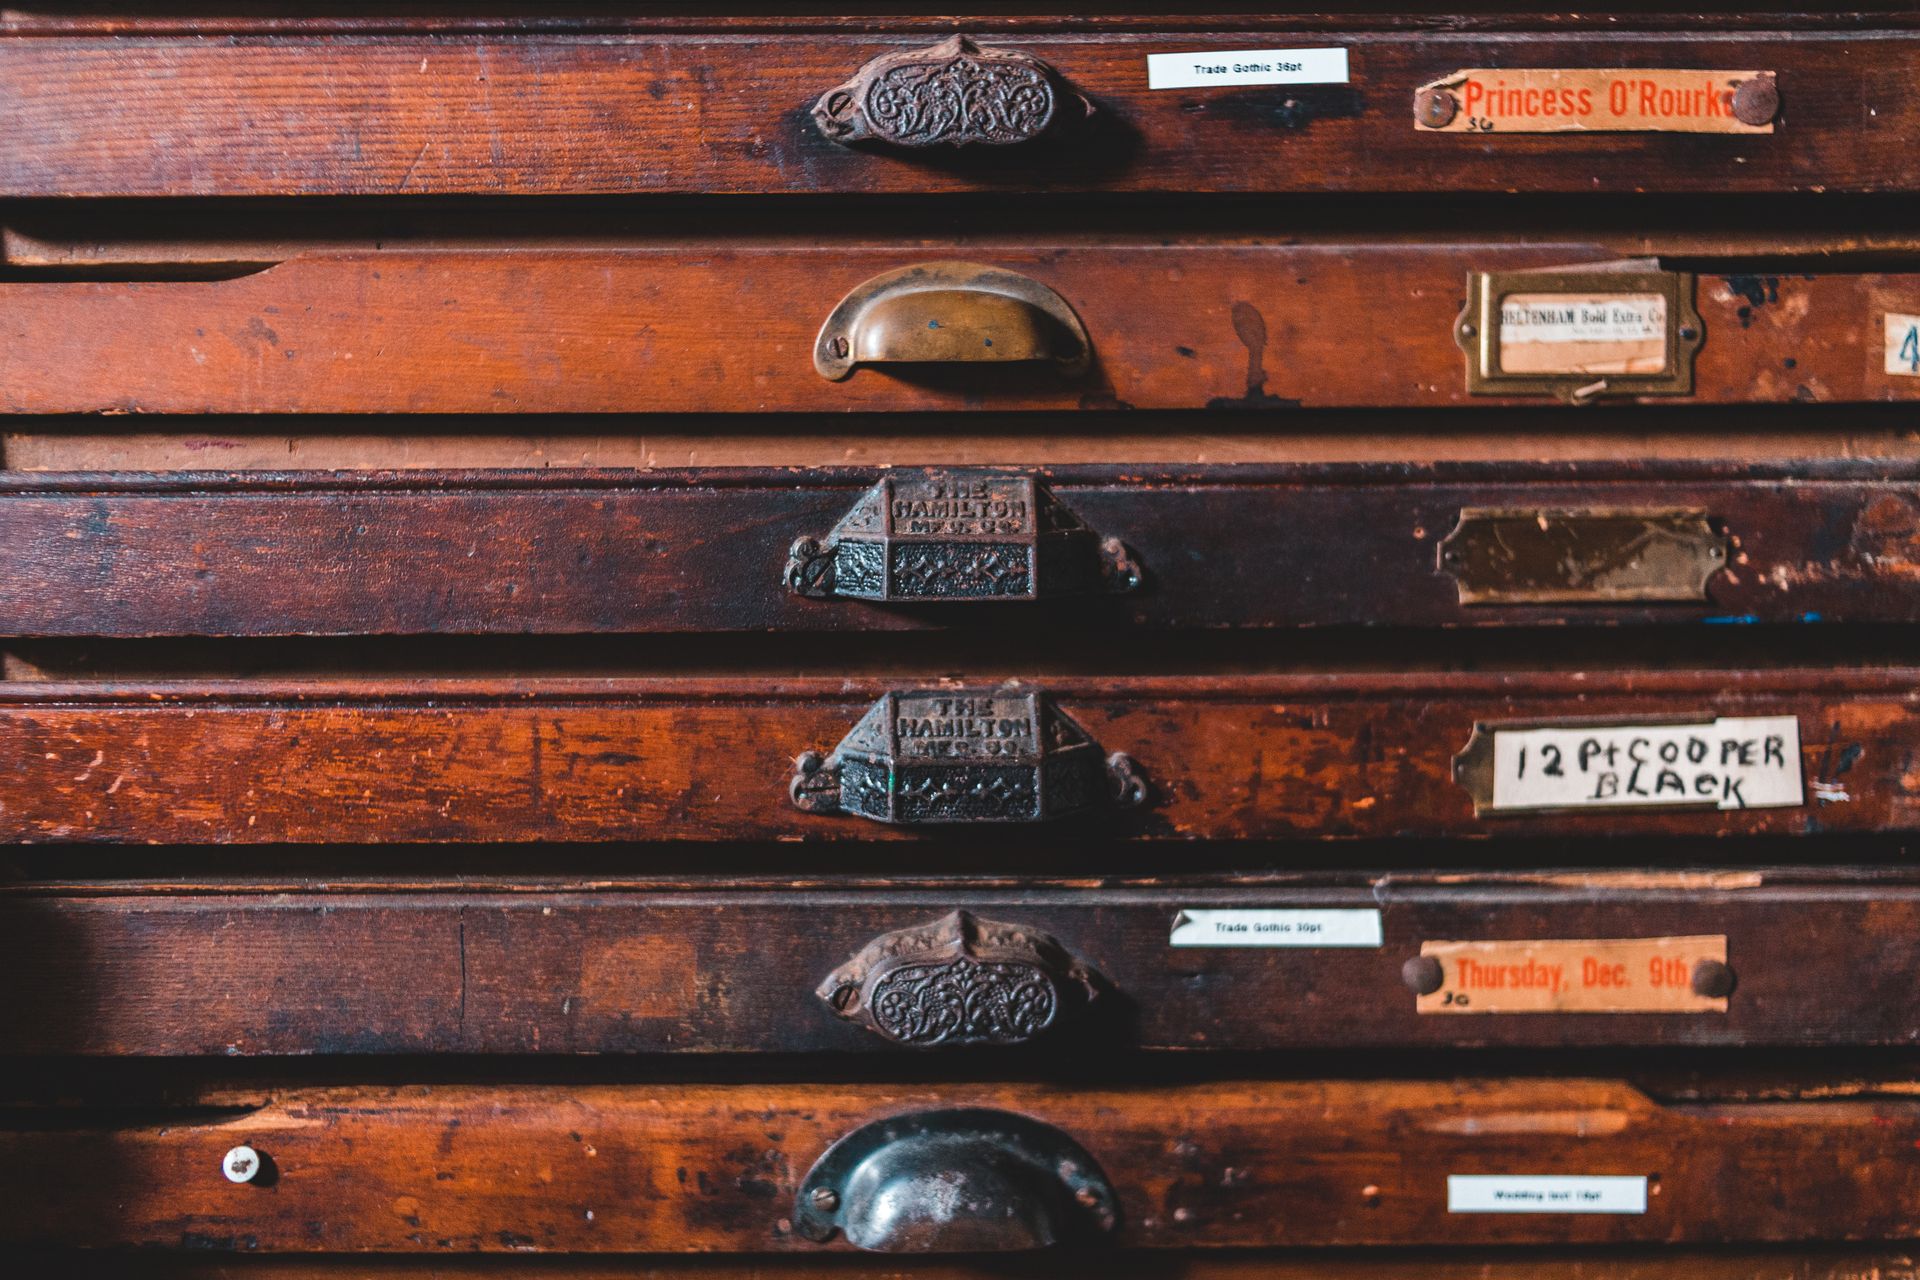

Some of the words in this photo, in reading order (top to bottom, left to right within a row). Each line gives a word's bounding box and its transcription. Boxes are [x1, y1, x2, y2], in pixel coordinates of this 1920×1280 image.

[1194, 65, 1227, 74] Trade
[1233, 63, 1272, 73] Gothic
[1276, 62, 1303, 72] 36pt
[1465, 80, 1592, 118] Princess
[1581, 308, 1606, 325] Bold
[1612, 307, 1642, 325] Extra
[893, 500, 1026, 518] HAMILTON
[934, 699, 994, 716] THE
[898, 718, 1031, 738] HAMILTON
[1517, 744, 1564, 780] 12
[1215, 923, 1248, 932] Trade
[1253, 922, 1291, 932] Gothic
[1456, 957, 1570, 994] Thursday,
[1582, 956, 1631, 988] Dec.
